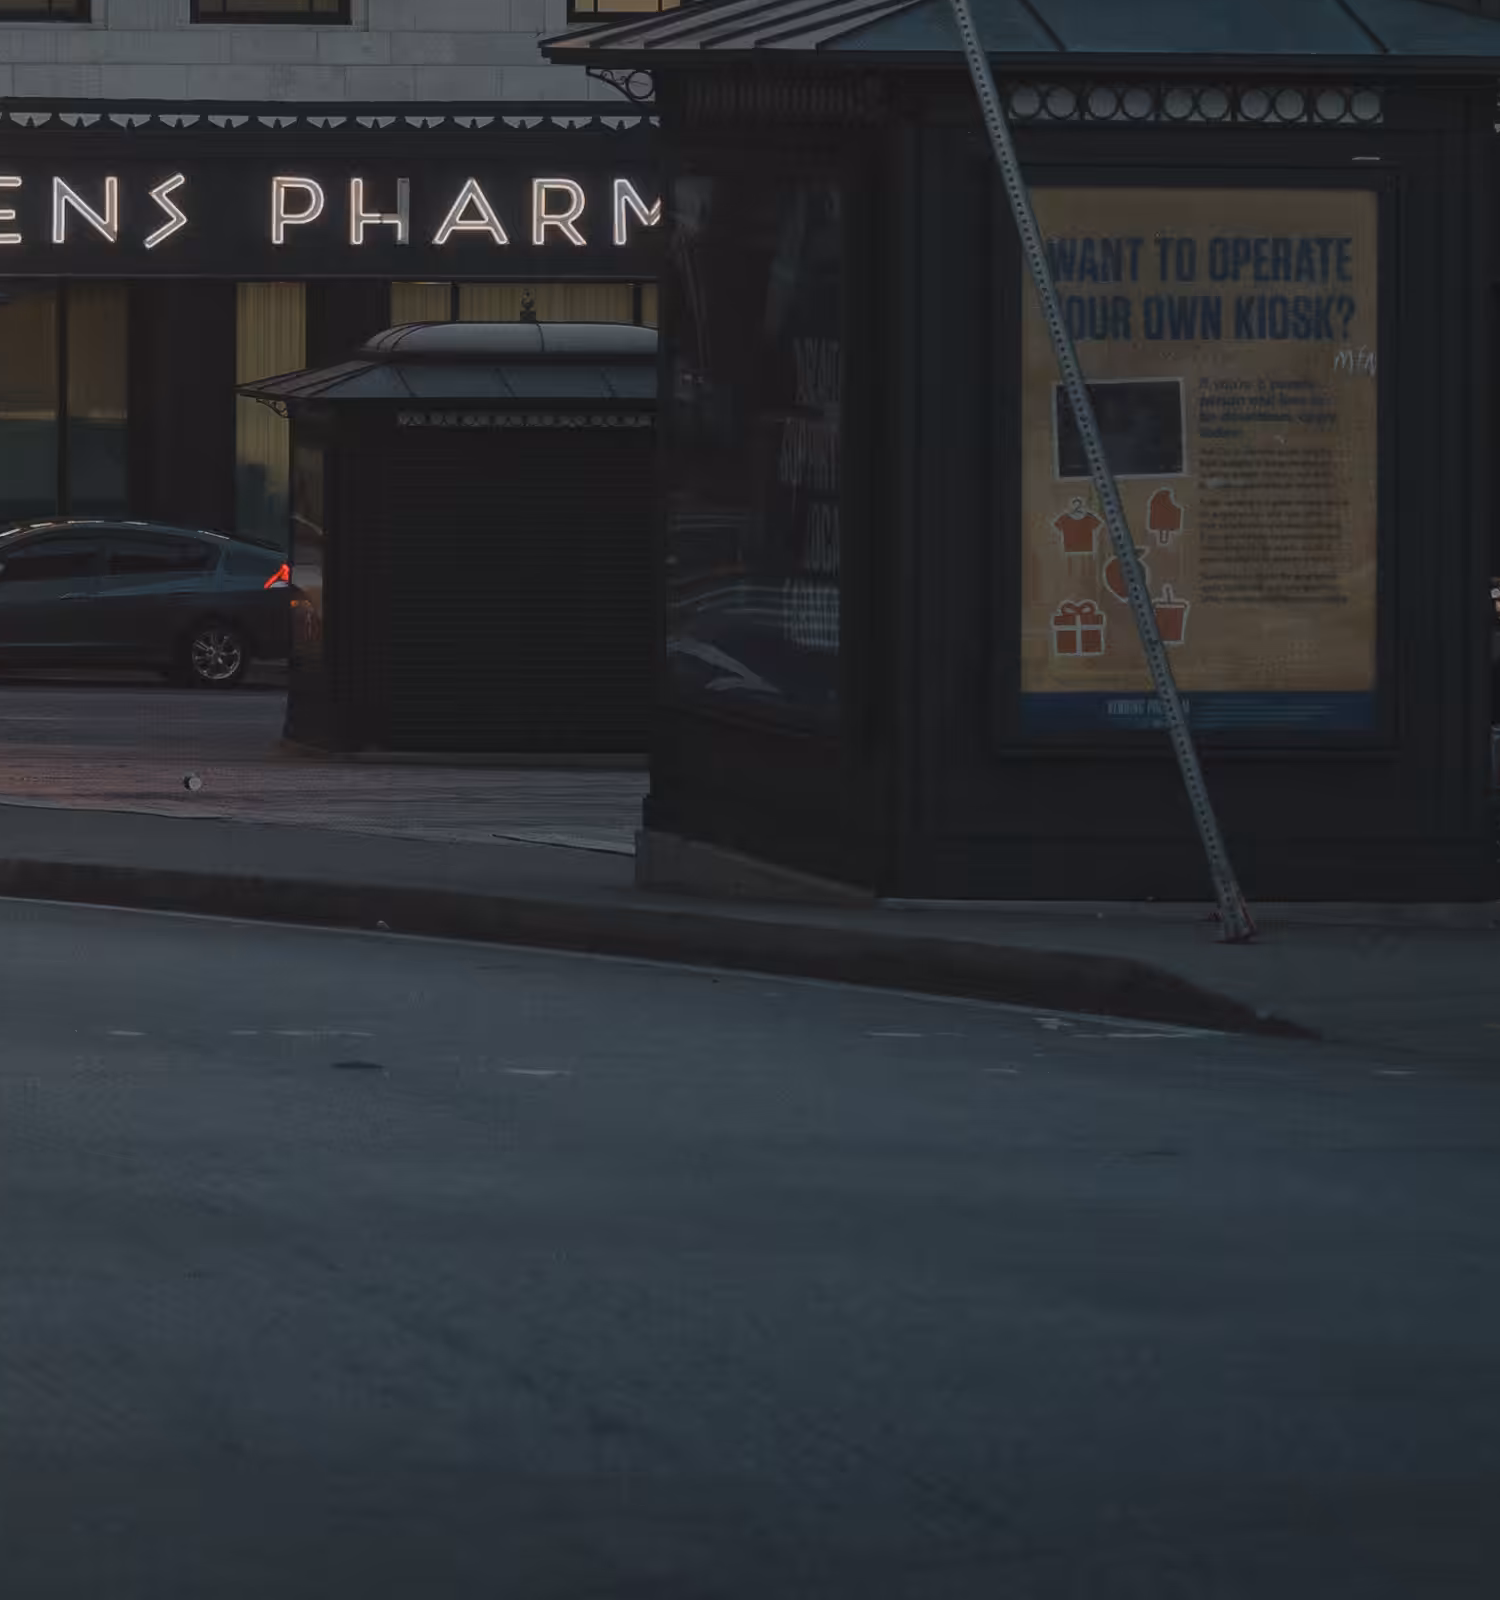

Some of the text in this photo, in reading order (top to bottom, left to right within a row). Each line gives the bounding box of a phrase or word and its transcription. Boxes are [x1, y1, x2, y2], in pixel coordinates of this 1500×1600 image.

[270, 174, 662, 247] PHARM
[1045, 236, 1354, 282] WANT TO OPERATE
[1143, 294, 1222, 340] OWN
[1234, 294, 1356, 340] KIOSK?
